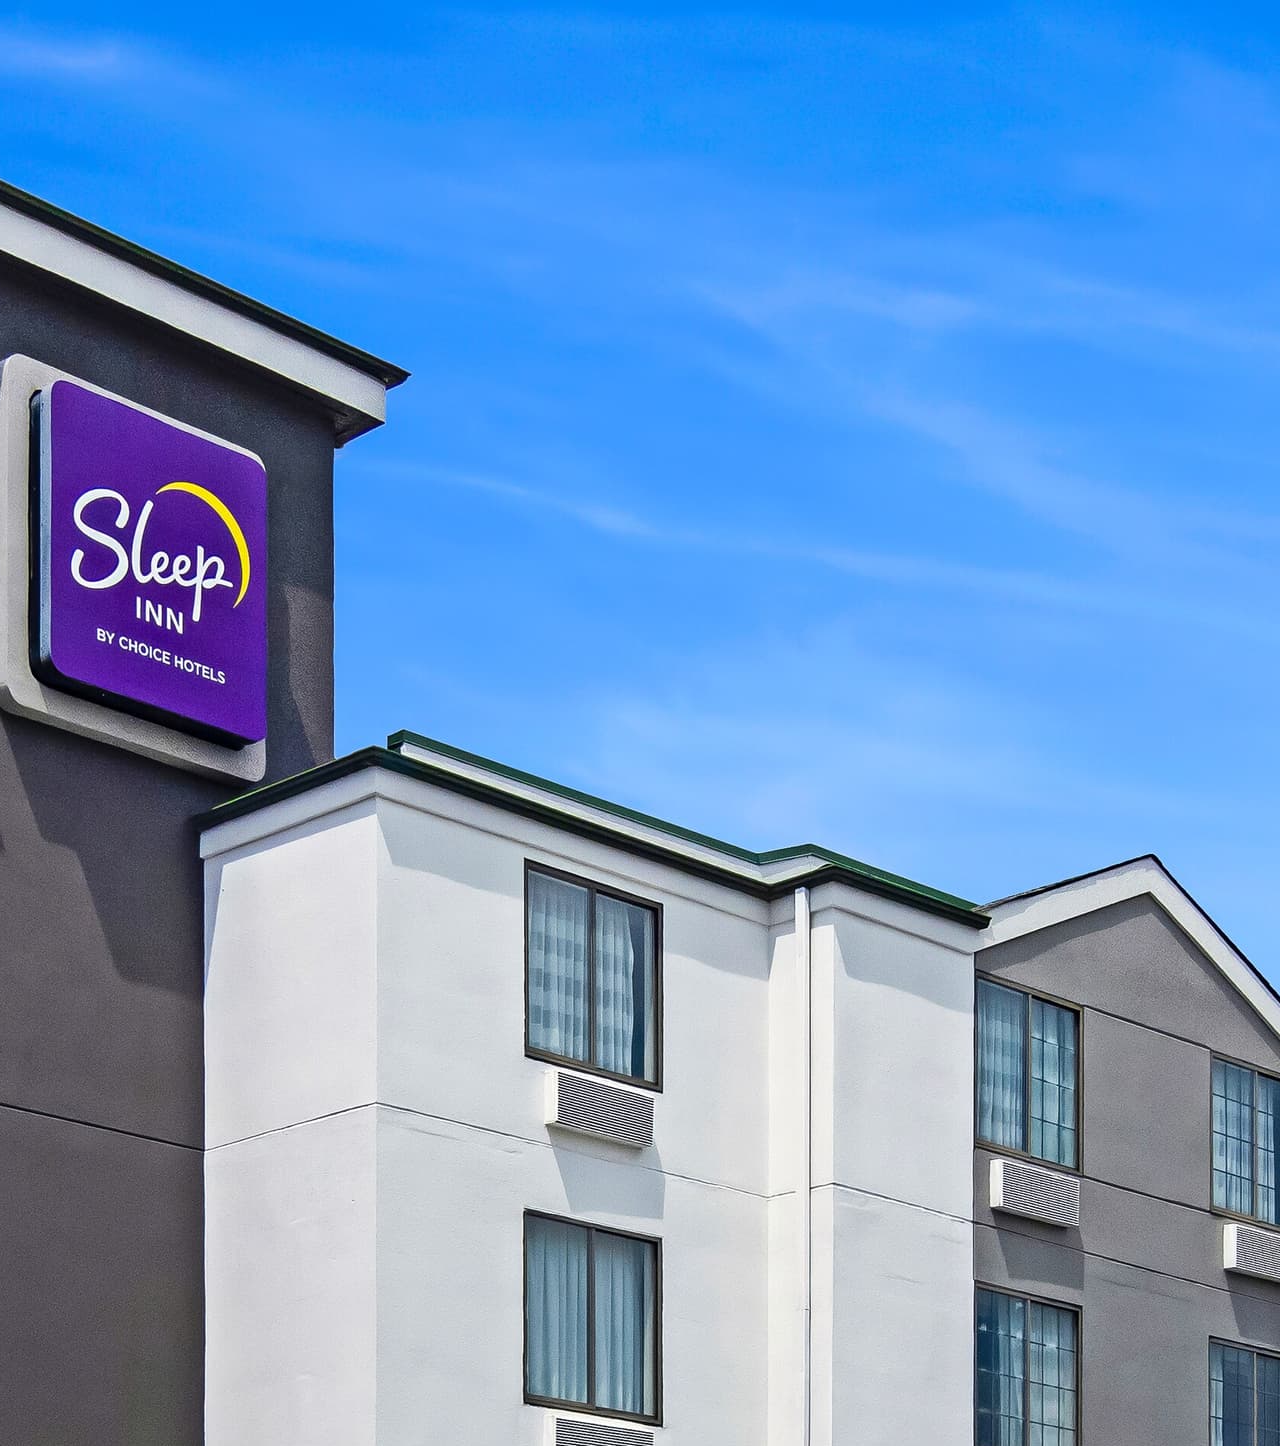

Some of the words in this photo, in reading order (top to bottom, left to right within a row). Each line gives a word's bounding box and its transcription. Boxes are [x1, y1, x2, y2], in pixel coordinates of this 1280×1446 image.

[70, 487, 234, 623] Sleep
[135, 596, 184, 635] INN
[95, 627, 115, 645] BY
[118, 635, 171, 666] CHOICE
[174, 654, 226, 684] HOTELS
